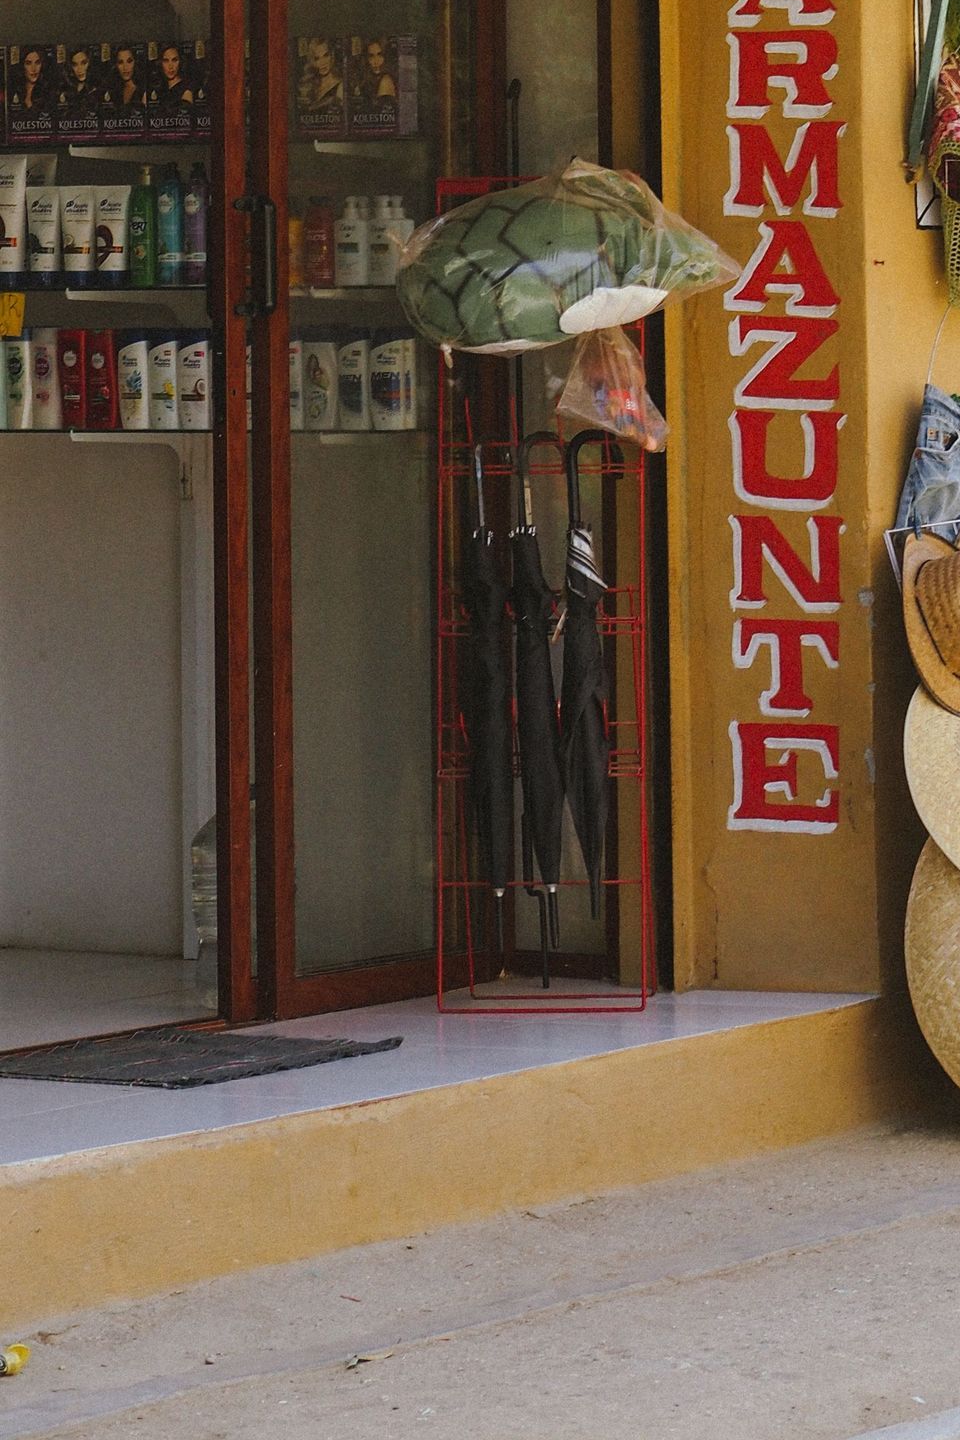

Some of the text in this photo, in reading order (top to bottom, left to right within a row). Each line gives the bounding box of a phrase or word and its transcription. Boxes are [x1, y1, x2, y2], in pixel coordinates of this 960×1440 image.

[104, 118, 143, 130] KOLESTON
[150, 117, 190, 128] KOLESTON
[352, 113, 396, 124] KOLESTON
[12, 120, 52, 131] KOLESTON
[58, 119, 98, 130] KOLESTON
